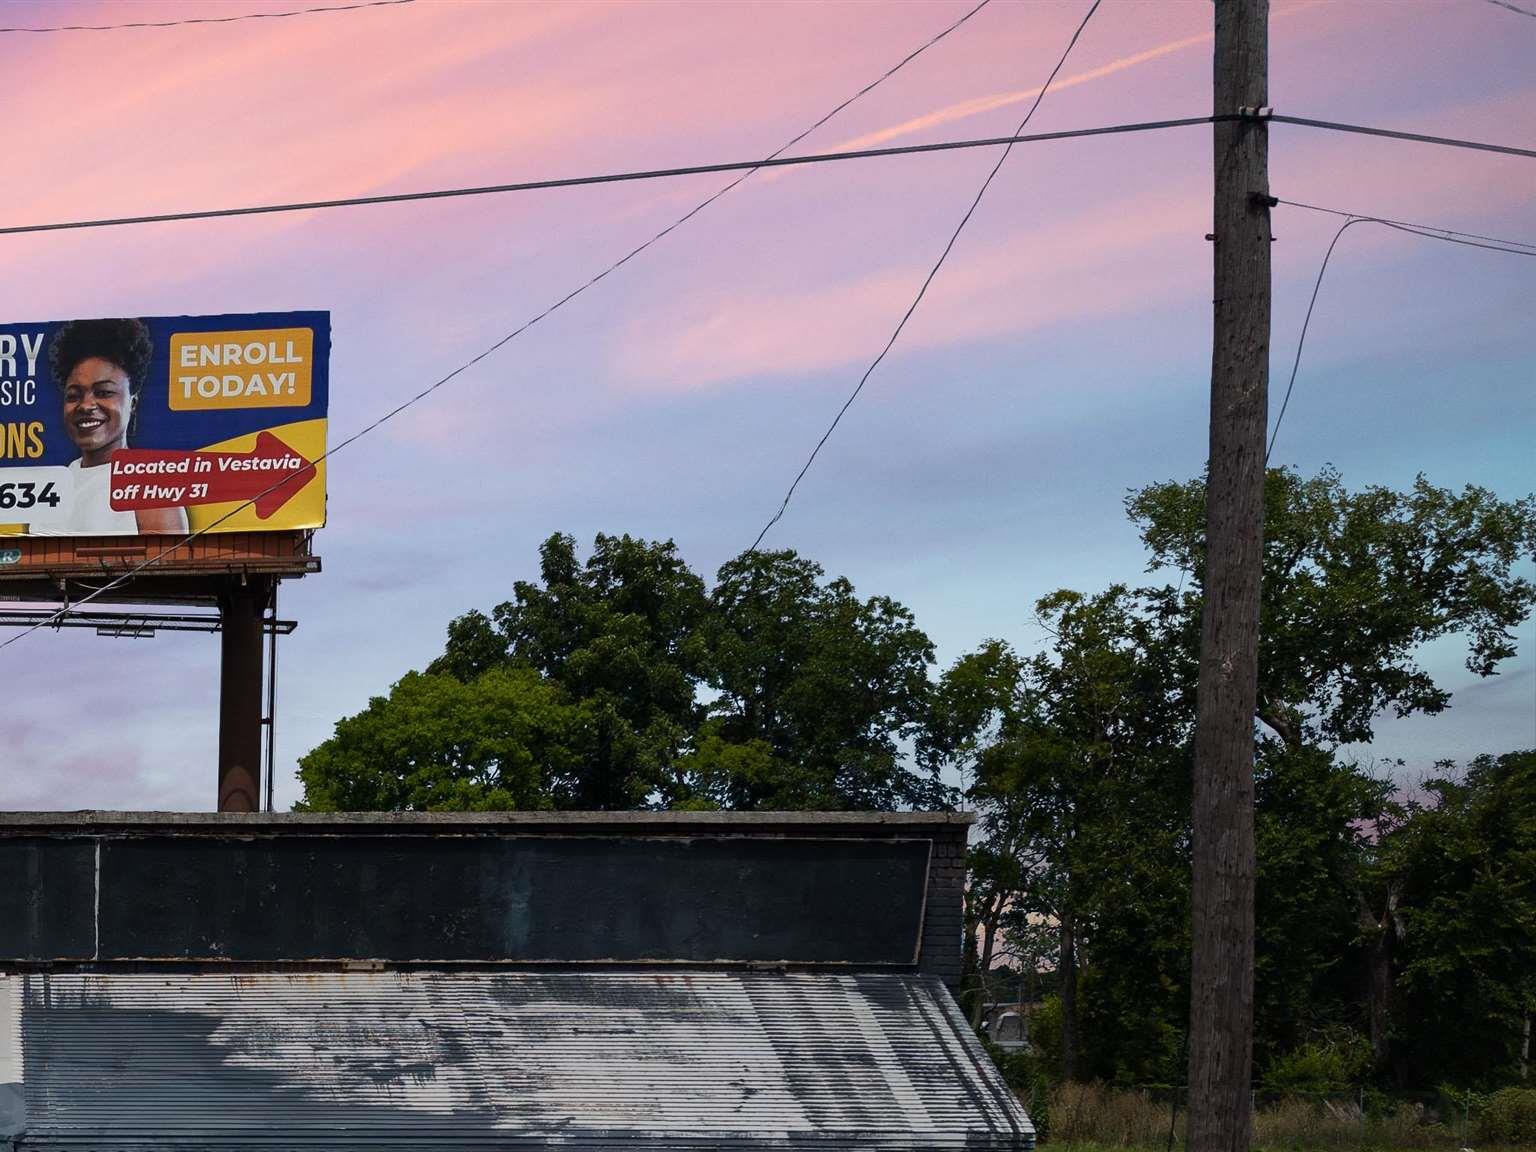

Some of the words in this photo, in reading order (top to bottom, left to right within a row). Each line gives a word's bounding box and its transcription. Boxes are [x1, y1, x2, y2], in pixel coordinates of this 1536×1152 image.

[181, 341, 303, 367] ENROLL
[178, 372, 296, 398] TODAY!
[113, 458, 190, 475] Located
[194, 457, 212, 472] in
[218, 454, 302, 472] Vestavia
[112, 484, 140, 500] off
[143, 485, 186, 502] Hwy
[189, 483, 209, 498] 31
